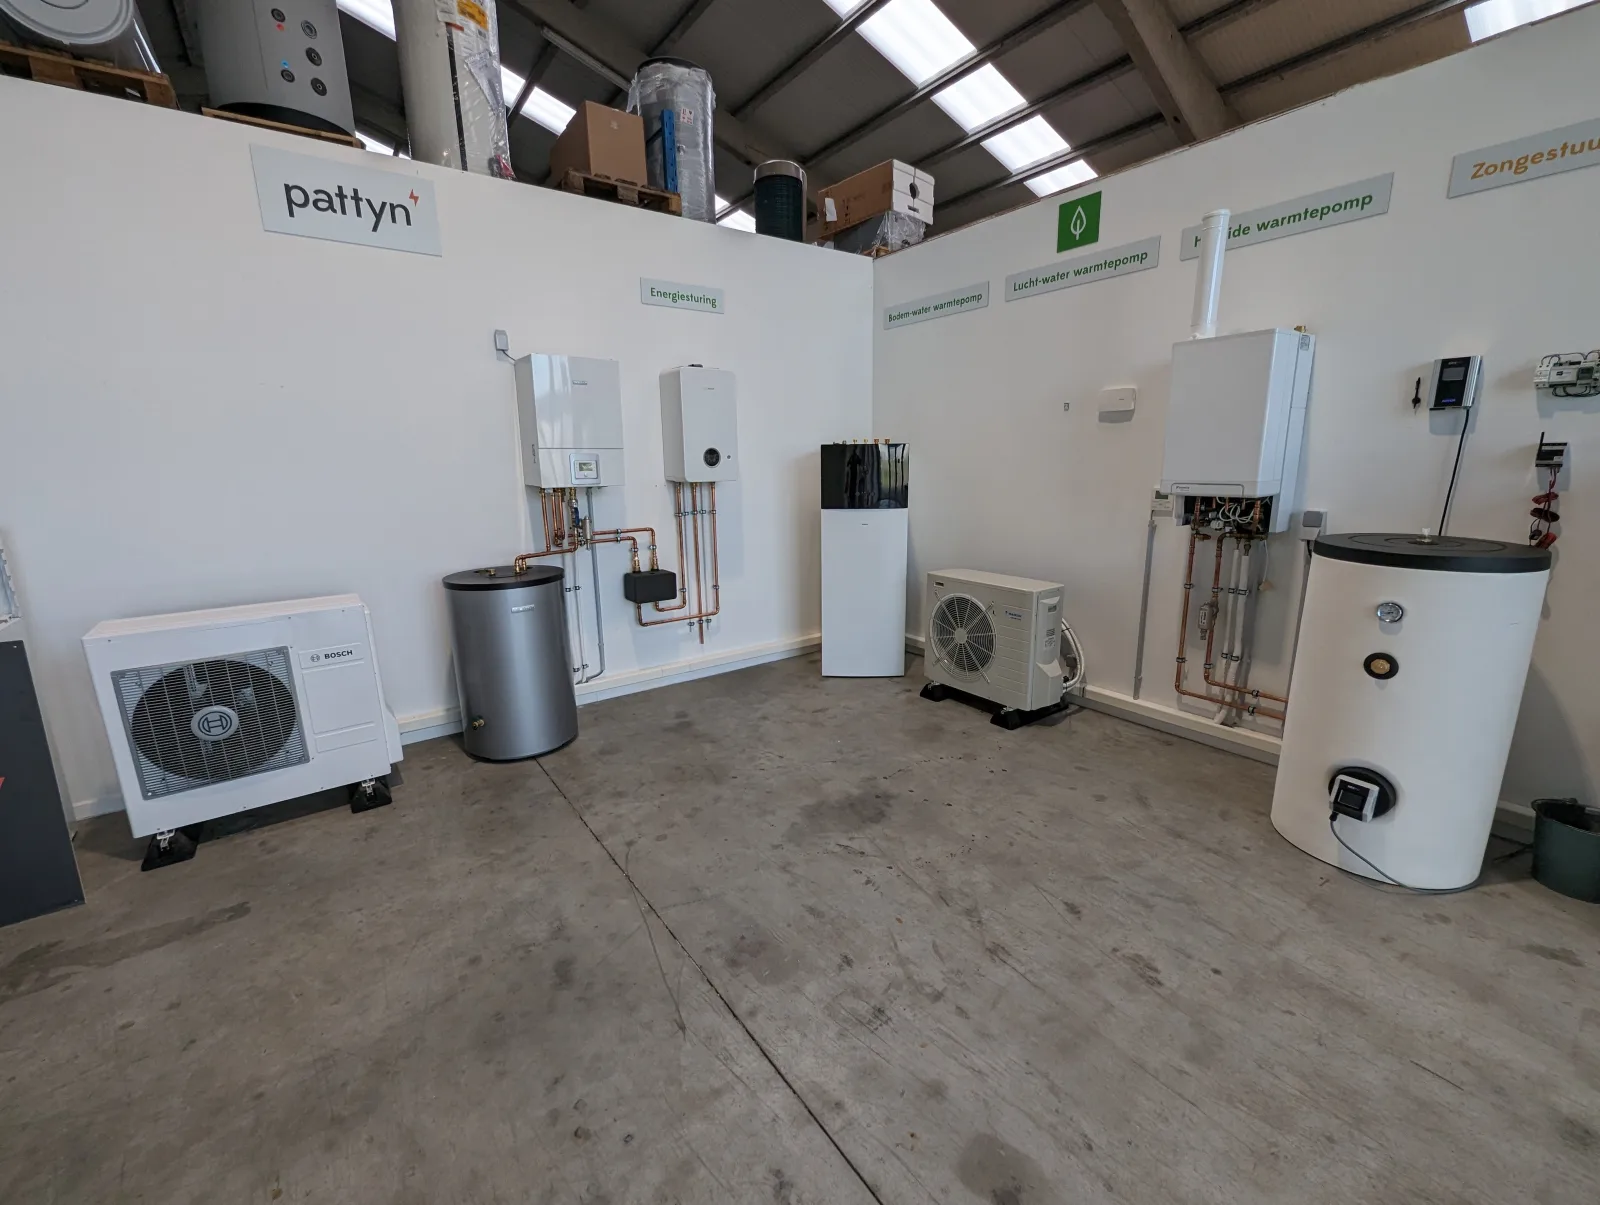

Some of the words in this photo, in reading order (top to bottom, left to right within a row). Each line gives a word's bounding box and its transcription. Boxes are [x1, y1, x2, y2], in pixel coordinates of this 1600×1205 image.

[283, 182, 412, 233] pattyn
[1256, 194, 1373, 232] warmtepomp
[1013, 270, 1071, 292] Lucht-water
[1073, 251, 1148, 277] warmtepomp
[650, 287, 717, 309] Energiesturing
[888, 305, 931, 323] Bodem-water
[933, 293, 983, 312] warmtepomp
[324, 649, 353, 660] BOSCH
